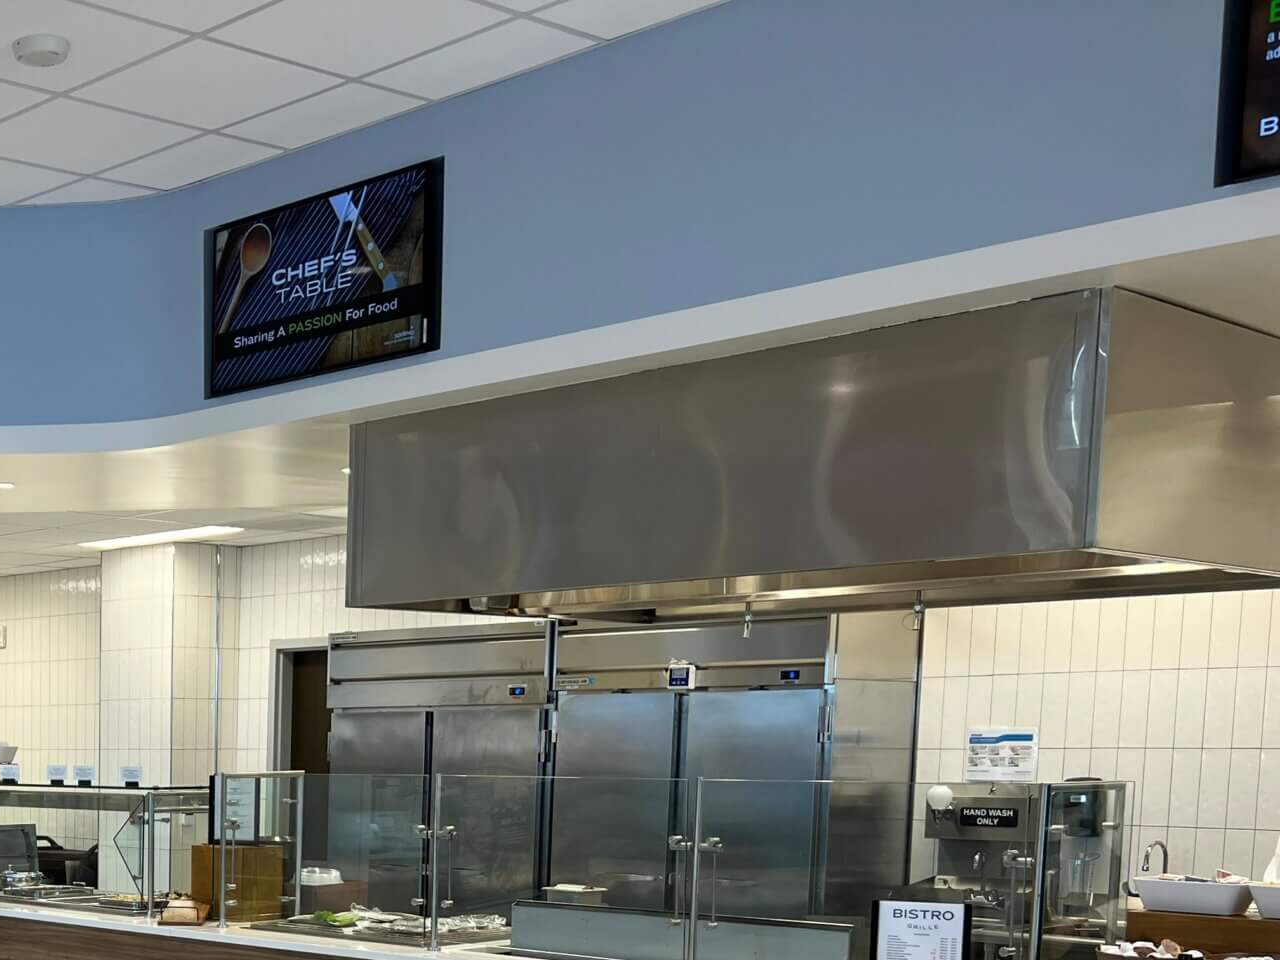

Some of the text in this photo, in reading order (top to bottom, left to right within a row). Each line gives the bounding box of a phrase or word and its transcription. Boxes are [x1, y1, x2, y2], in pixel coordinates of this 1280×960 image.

[271, 248, 358, 286] CHEF'S
[276, 271, 353, 304] TABLE
[233, 297, 399, 349] Sharing A PASSION For Food
[963, 807, 1014, 818] HAND WASH
[976, 817, 999, 826] ONLY
[893, 908, 955, 921] BISTRO
